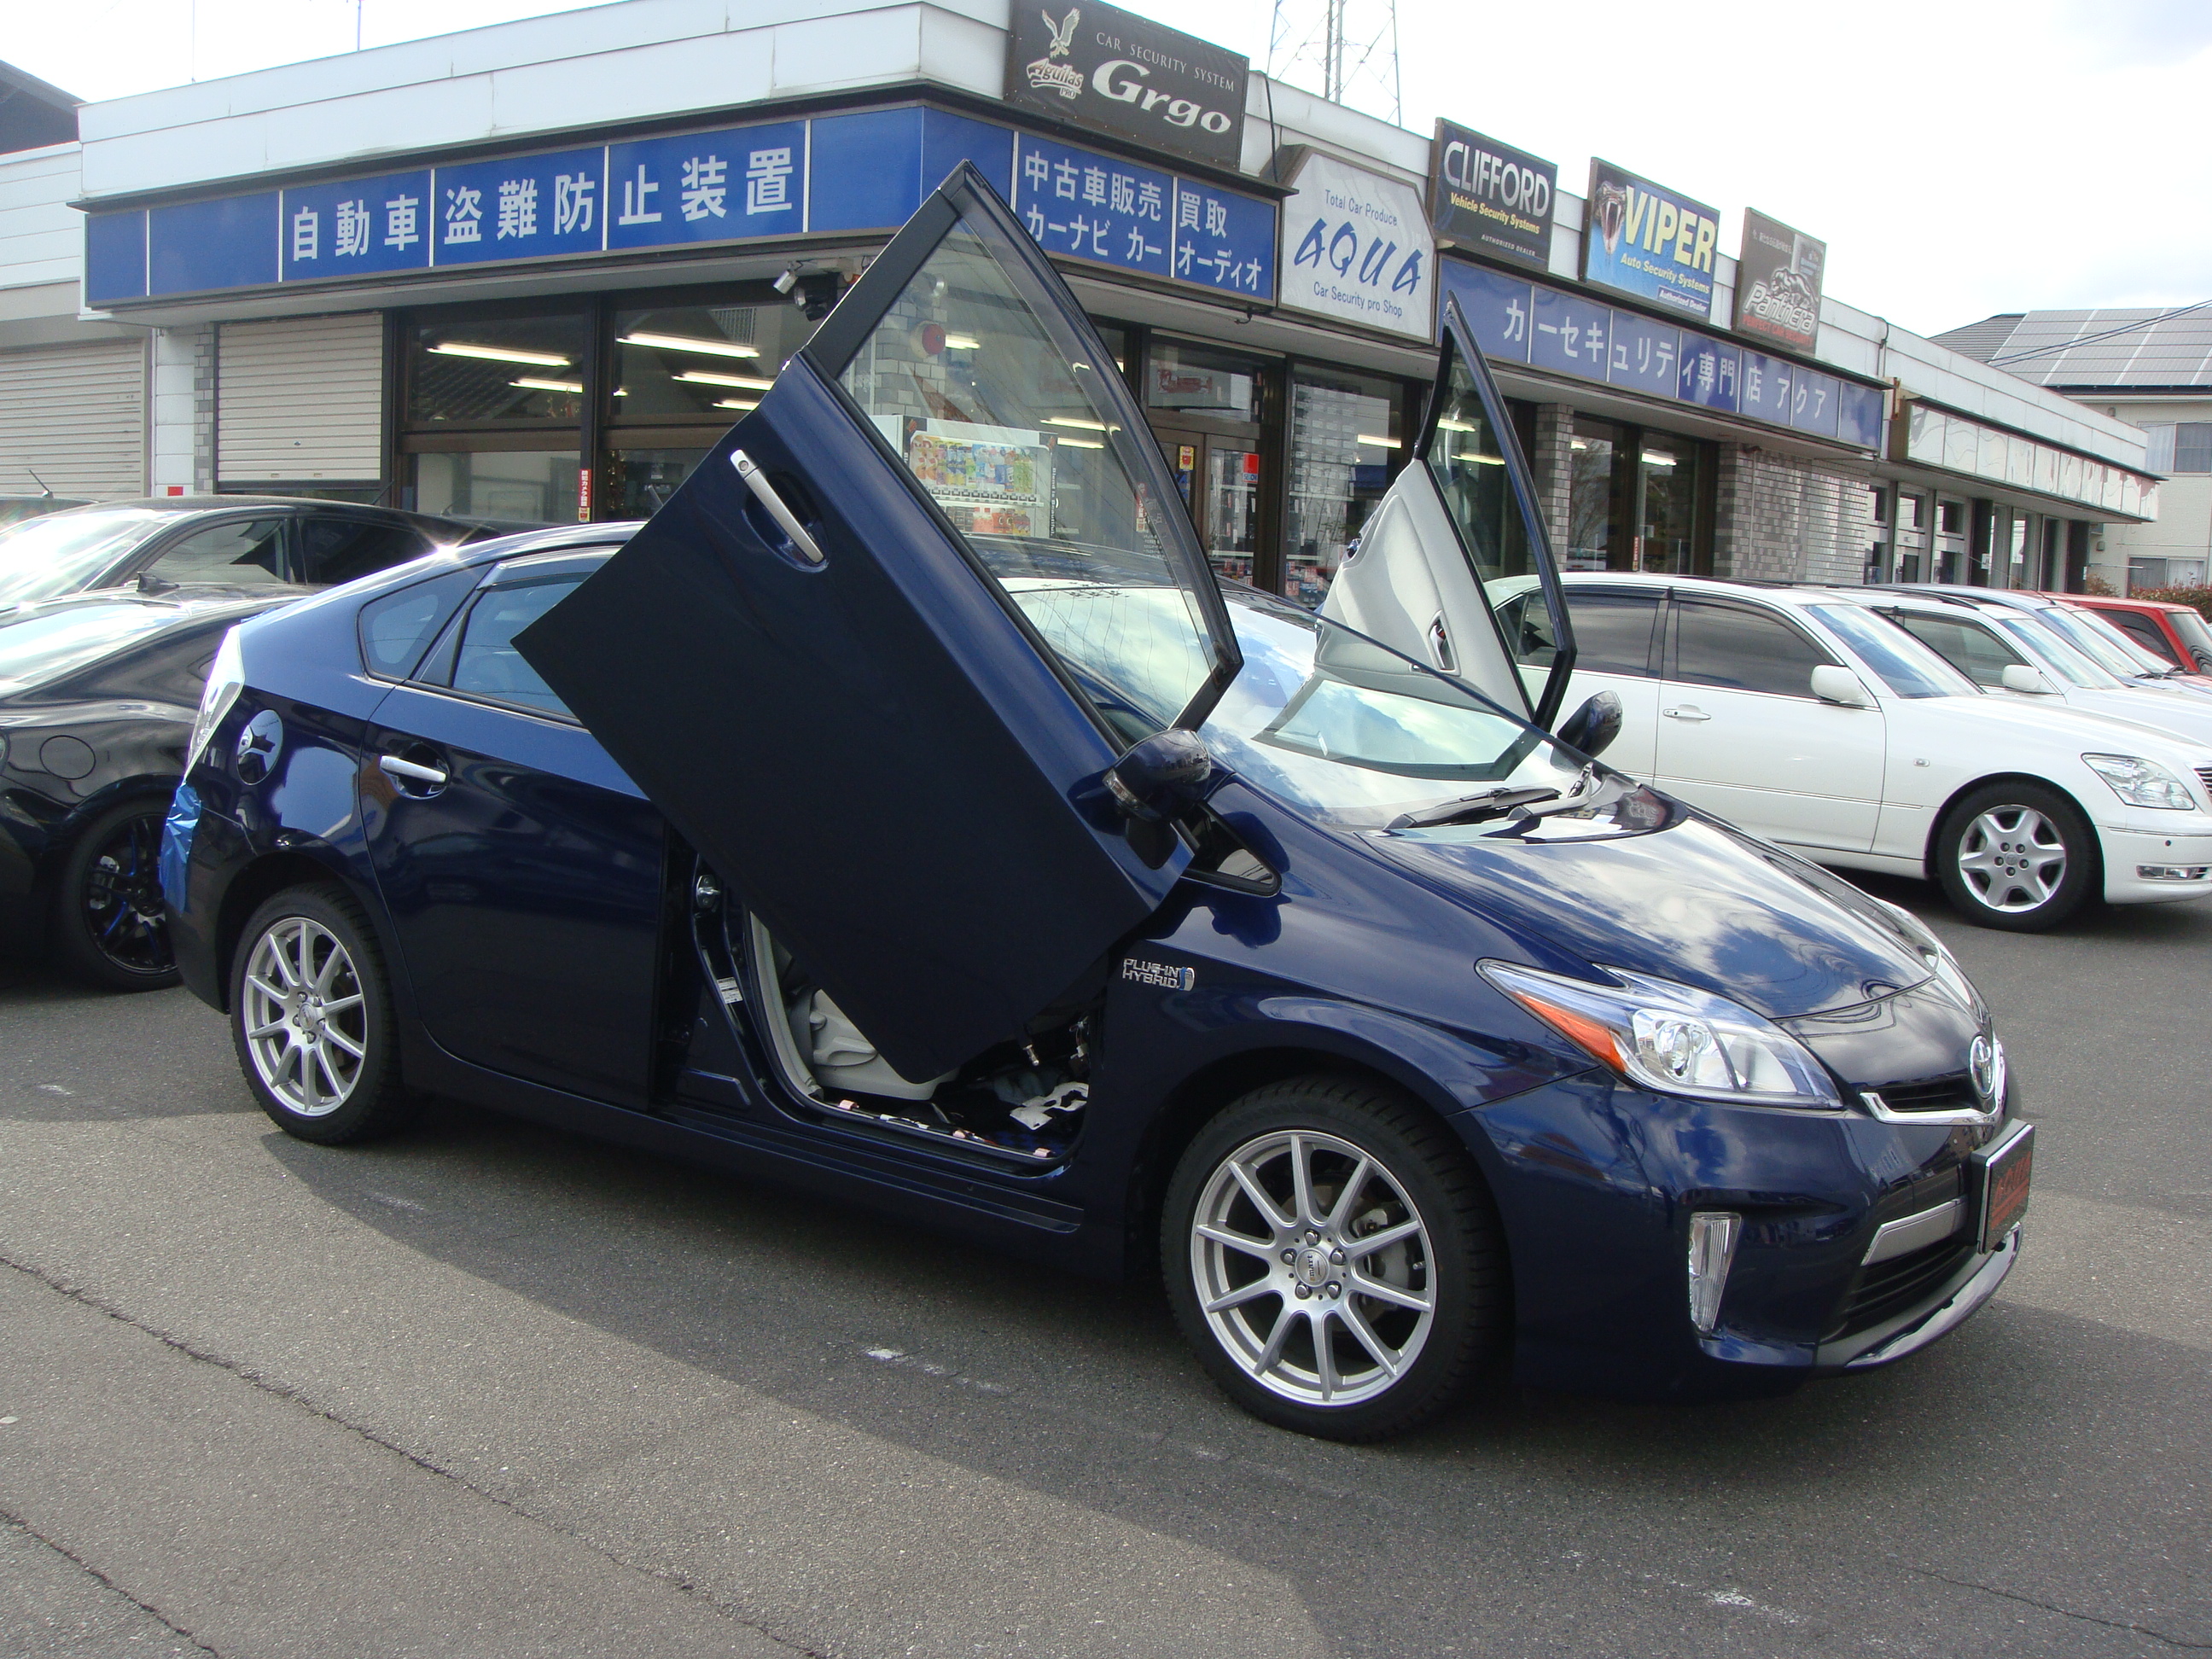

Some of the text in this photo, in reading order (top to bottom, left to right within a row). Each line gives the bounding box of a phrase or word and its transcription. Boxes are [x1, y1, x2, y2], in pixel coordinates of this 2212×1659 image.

[1097, 32, 1235, 92] CAR SECURITY SYSTEM
[1060, 87, 1075, 98] PRO
[1092, 59, 1231, 133] Grgo
[293, 147, 793, 262] 自動車盗難防止装置
[1025, 150, 1228, 239] 中古車販売 買取
[1444, 141, 1550, 218] CLIFFORD
[1026, 204, 1111, 257] カーナビ
[1324, 189, 1398, 227] Total Car Produce
[1451, 192, 1540, 235] Vehicle Security Systems
[1624, 184, 1717, 274] VIPER
[1294, 218, 1423, 296] AQUA
[1620, 253, 1710, 294] Auto Security Systems
[1313, 281, 1403, 318] Car Security pro Shop
[1503, 298, 1761, 403] カーセキュリティ専門店
[1122, 969, 1178, 989] HYBRID
[1123, 958, 1180, 977] PLUG-IN
